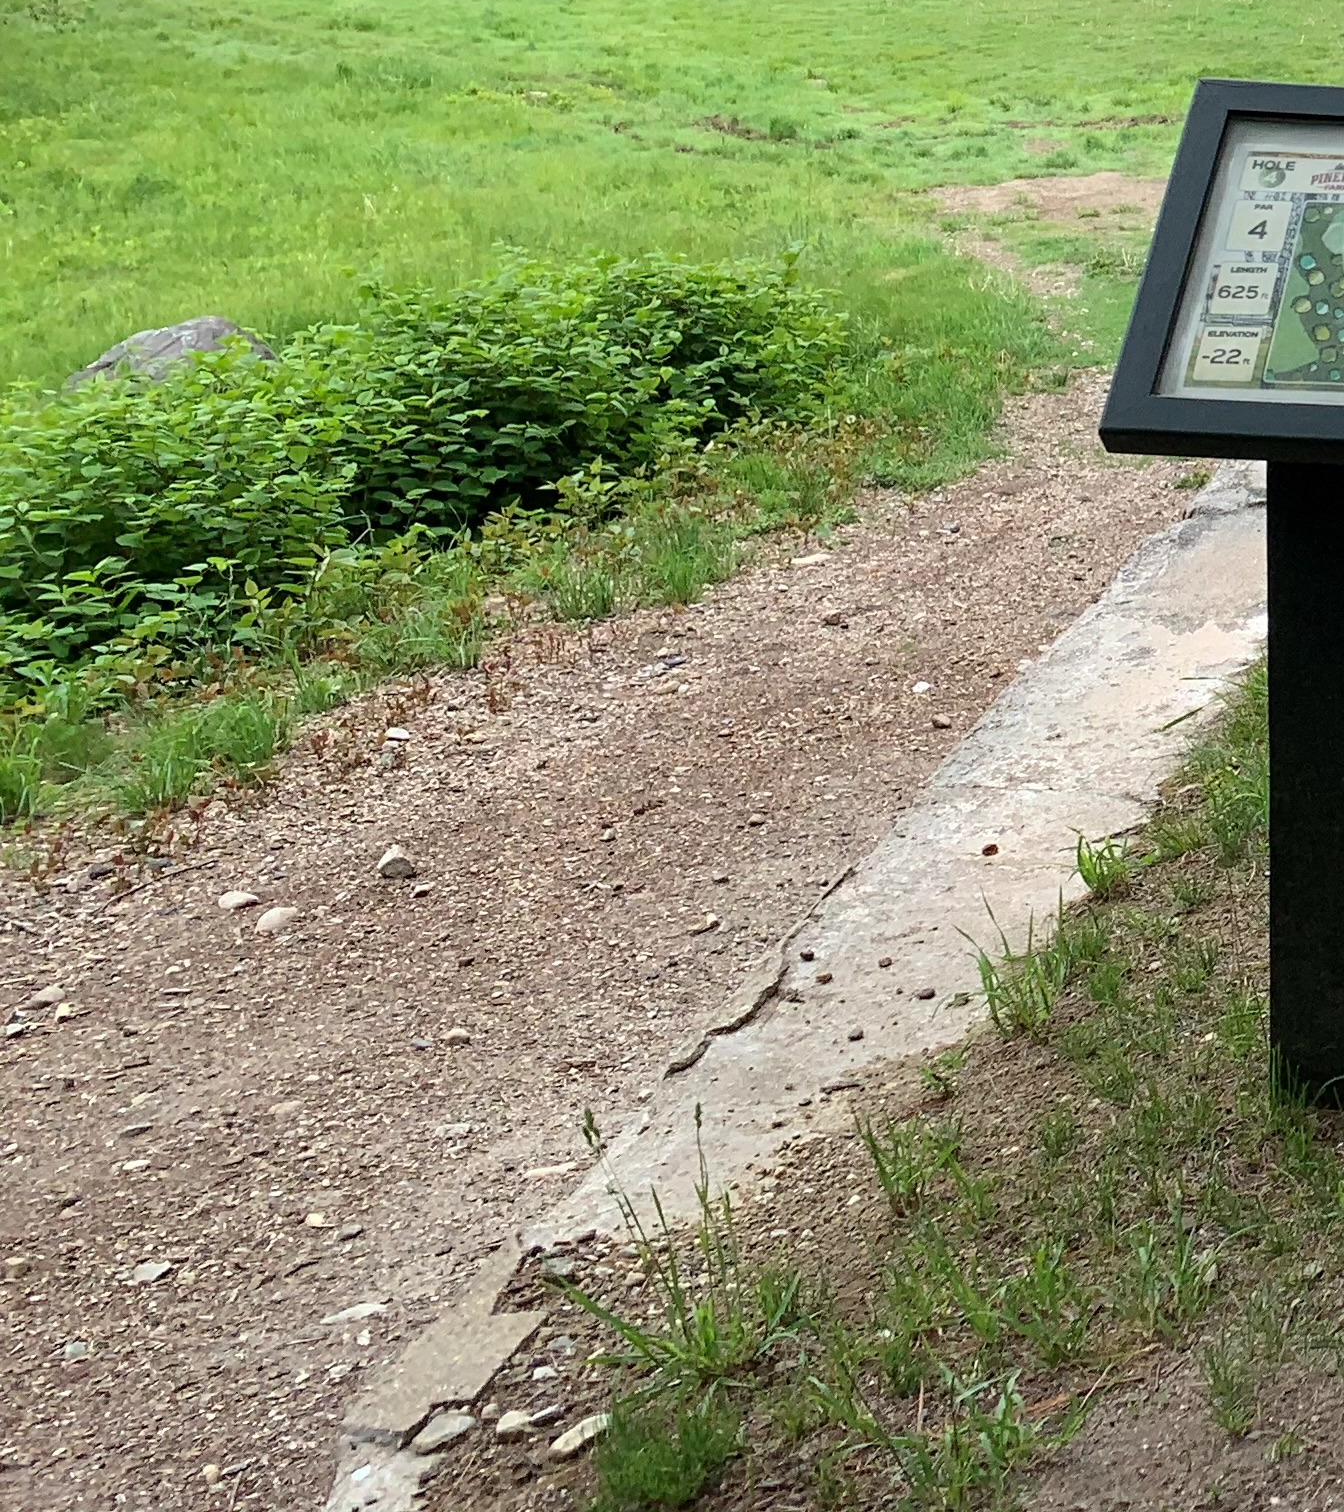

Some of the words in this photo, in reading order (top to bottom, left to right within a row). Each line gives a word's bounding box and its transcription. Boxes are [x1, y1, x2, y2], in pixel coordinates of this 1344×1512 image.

[1252, 159, 1296, 171] HOLE
[1263, 171, 1277, 184] 4
[1247, 219, 1268, 240] 4
[1230, 266, 1268, 274] LENGTH
[1218, 285, 1259, 300] 625
[1260, 292, 1269, 300] ft
[1207, 330, 1259, 338] ELEVATION
[1202, 348, 1242, 365] -22
